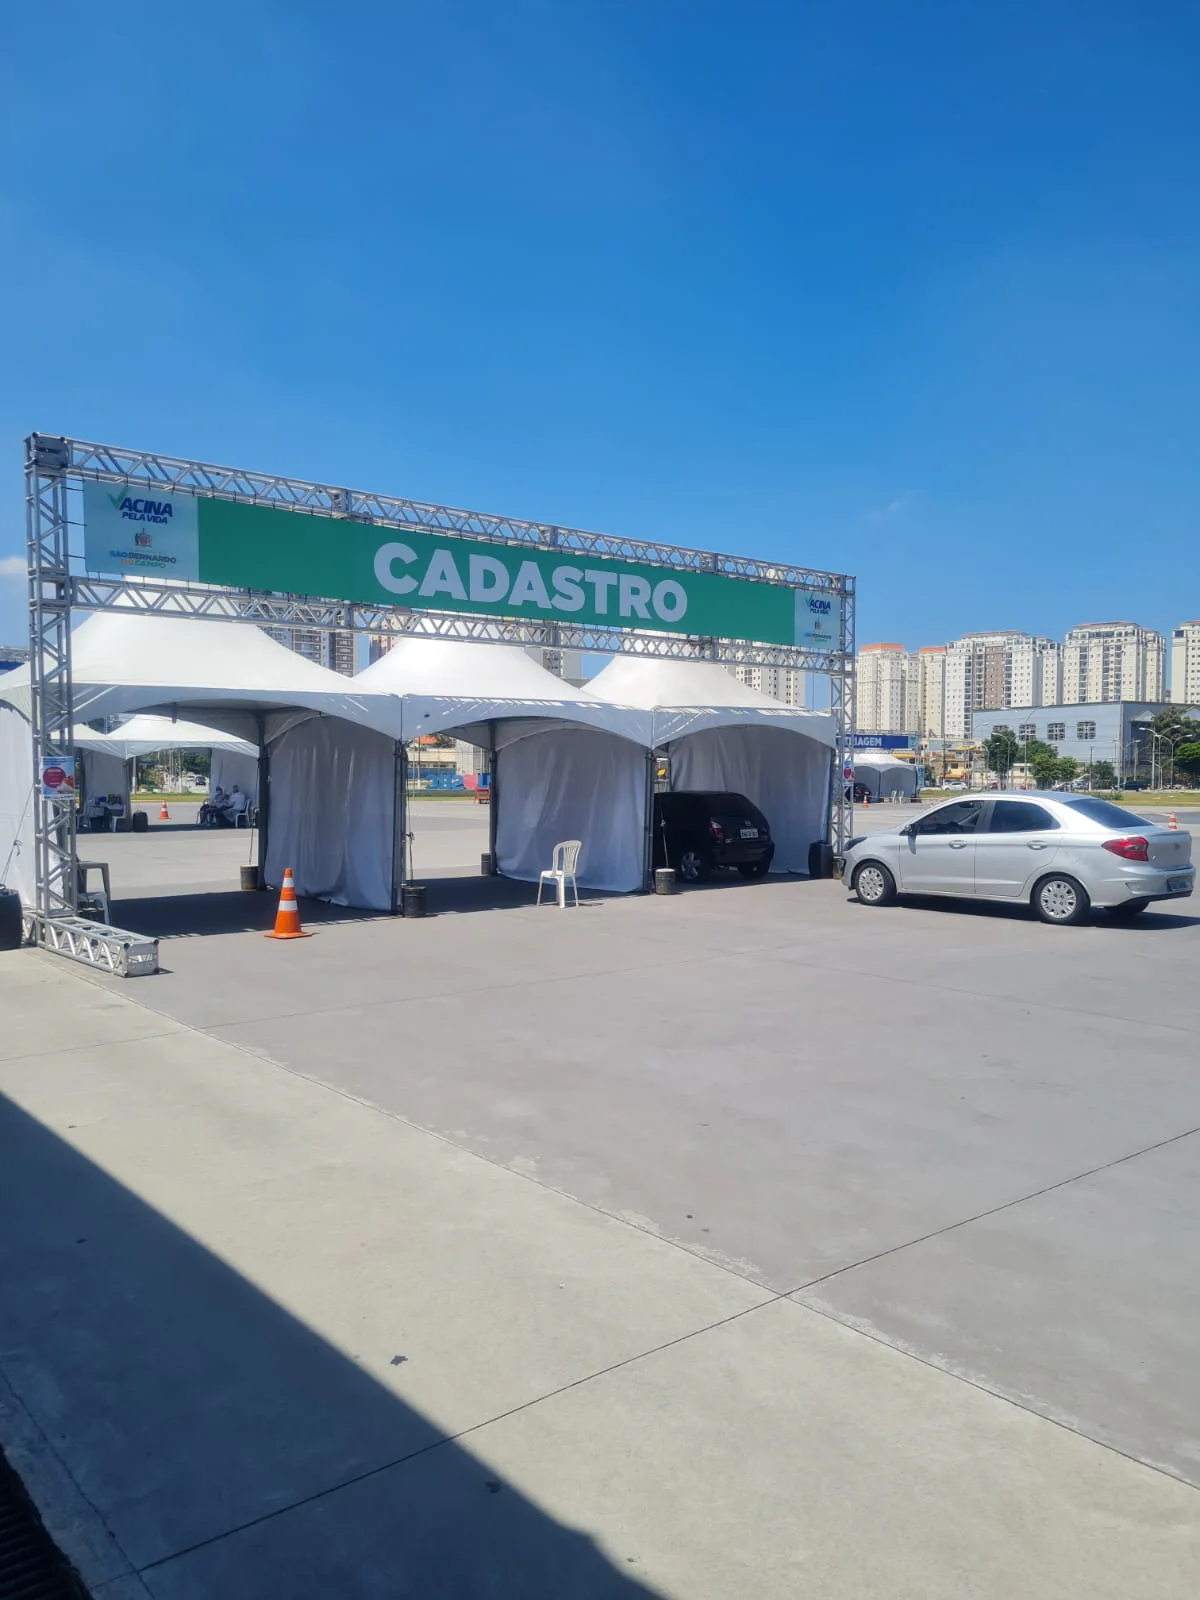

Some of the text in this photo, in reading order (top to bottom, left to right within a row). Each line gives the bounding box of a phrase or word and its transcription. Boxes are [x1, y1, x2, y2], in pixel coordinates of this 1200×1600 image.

[122, 512, 168, 524] PELA VIDA
[128, 552, 176, 563] BERNARDO
[373, 542, 688, 622] CADASTRO
